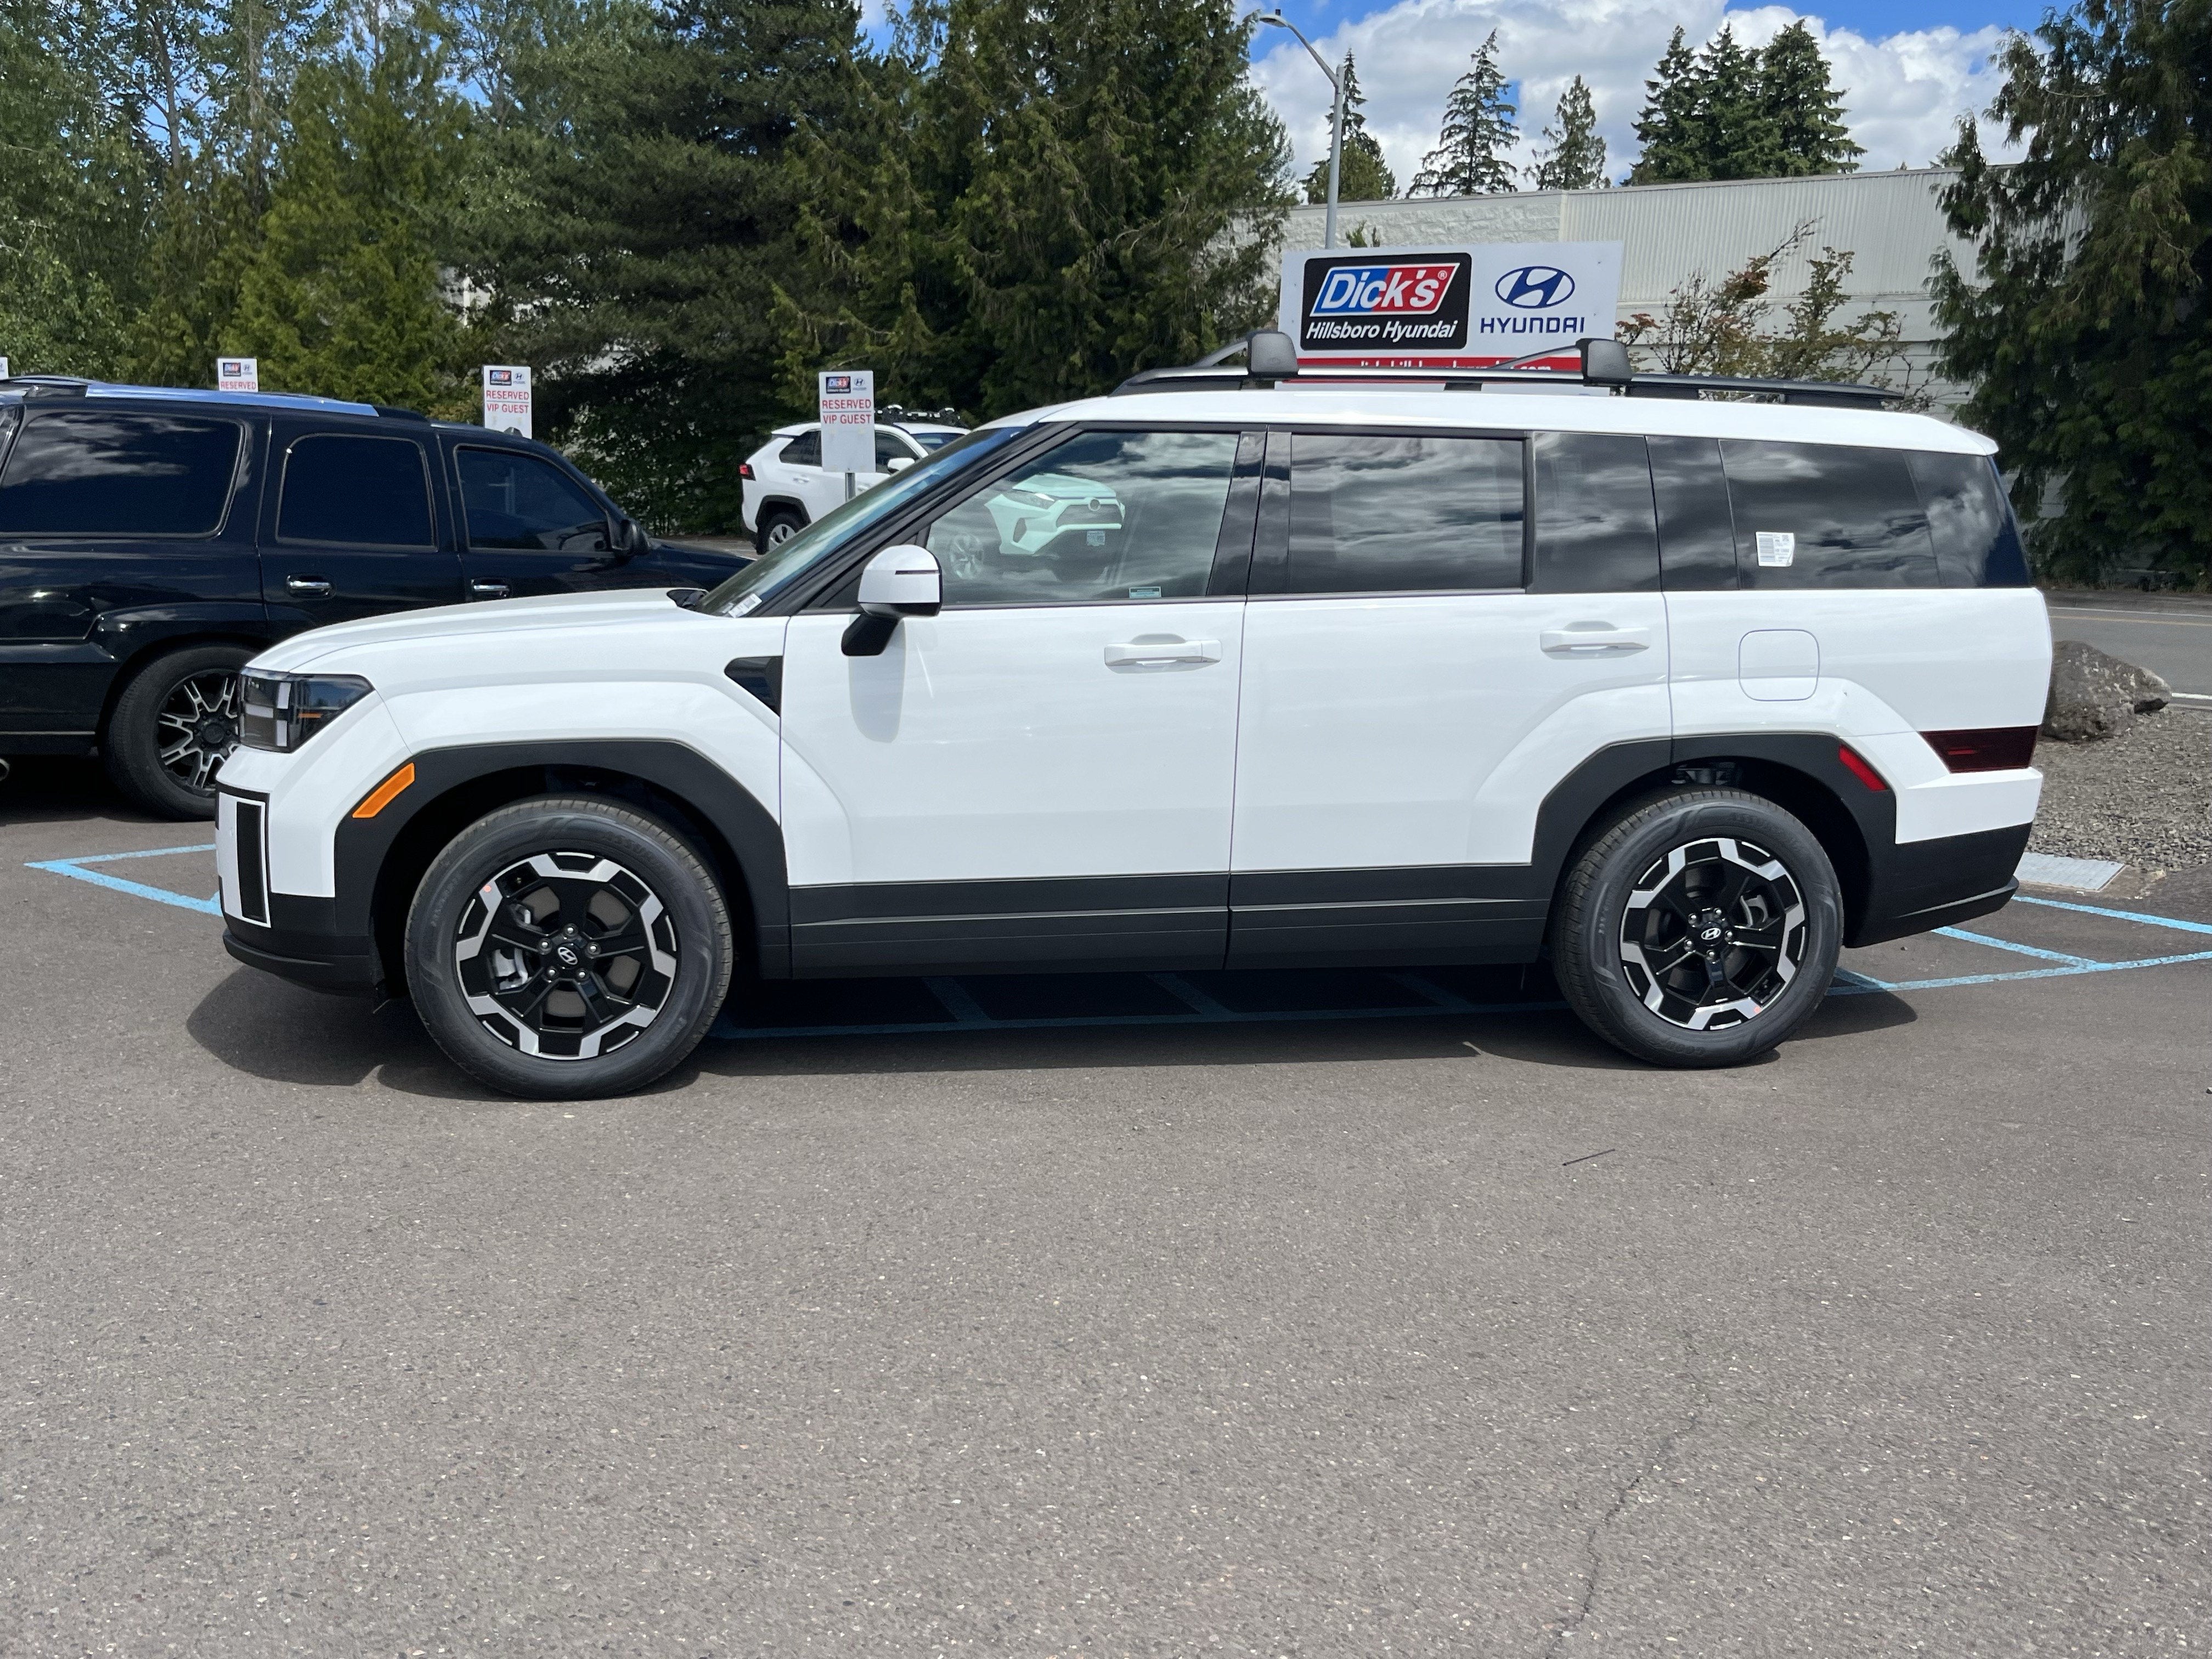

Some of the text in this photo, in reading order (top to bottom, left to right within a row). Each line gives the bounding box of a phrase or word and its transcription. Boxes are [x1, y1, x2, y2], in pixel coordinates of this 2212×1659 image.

[1321, 270, 1439, 309] Dick's
[1480, 317, 1585, 334] HYUNDAI
[1306, 320, 1458, 343] Hillsboro Hyundai
[220, 381, 256, 390] RESERVED
[486, 390, 529, 400] RESERVED
[487, 403, 529, 414] VIP GUEST
[822, 399, 871, 409] RESERVED
[823, 414, 872, 424] VIP GUEST
